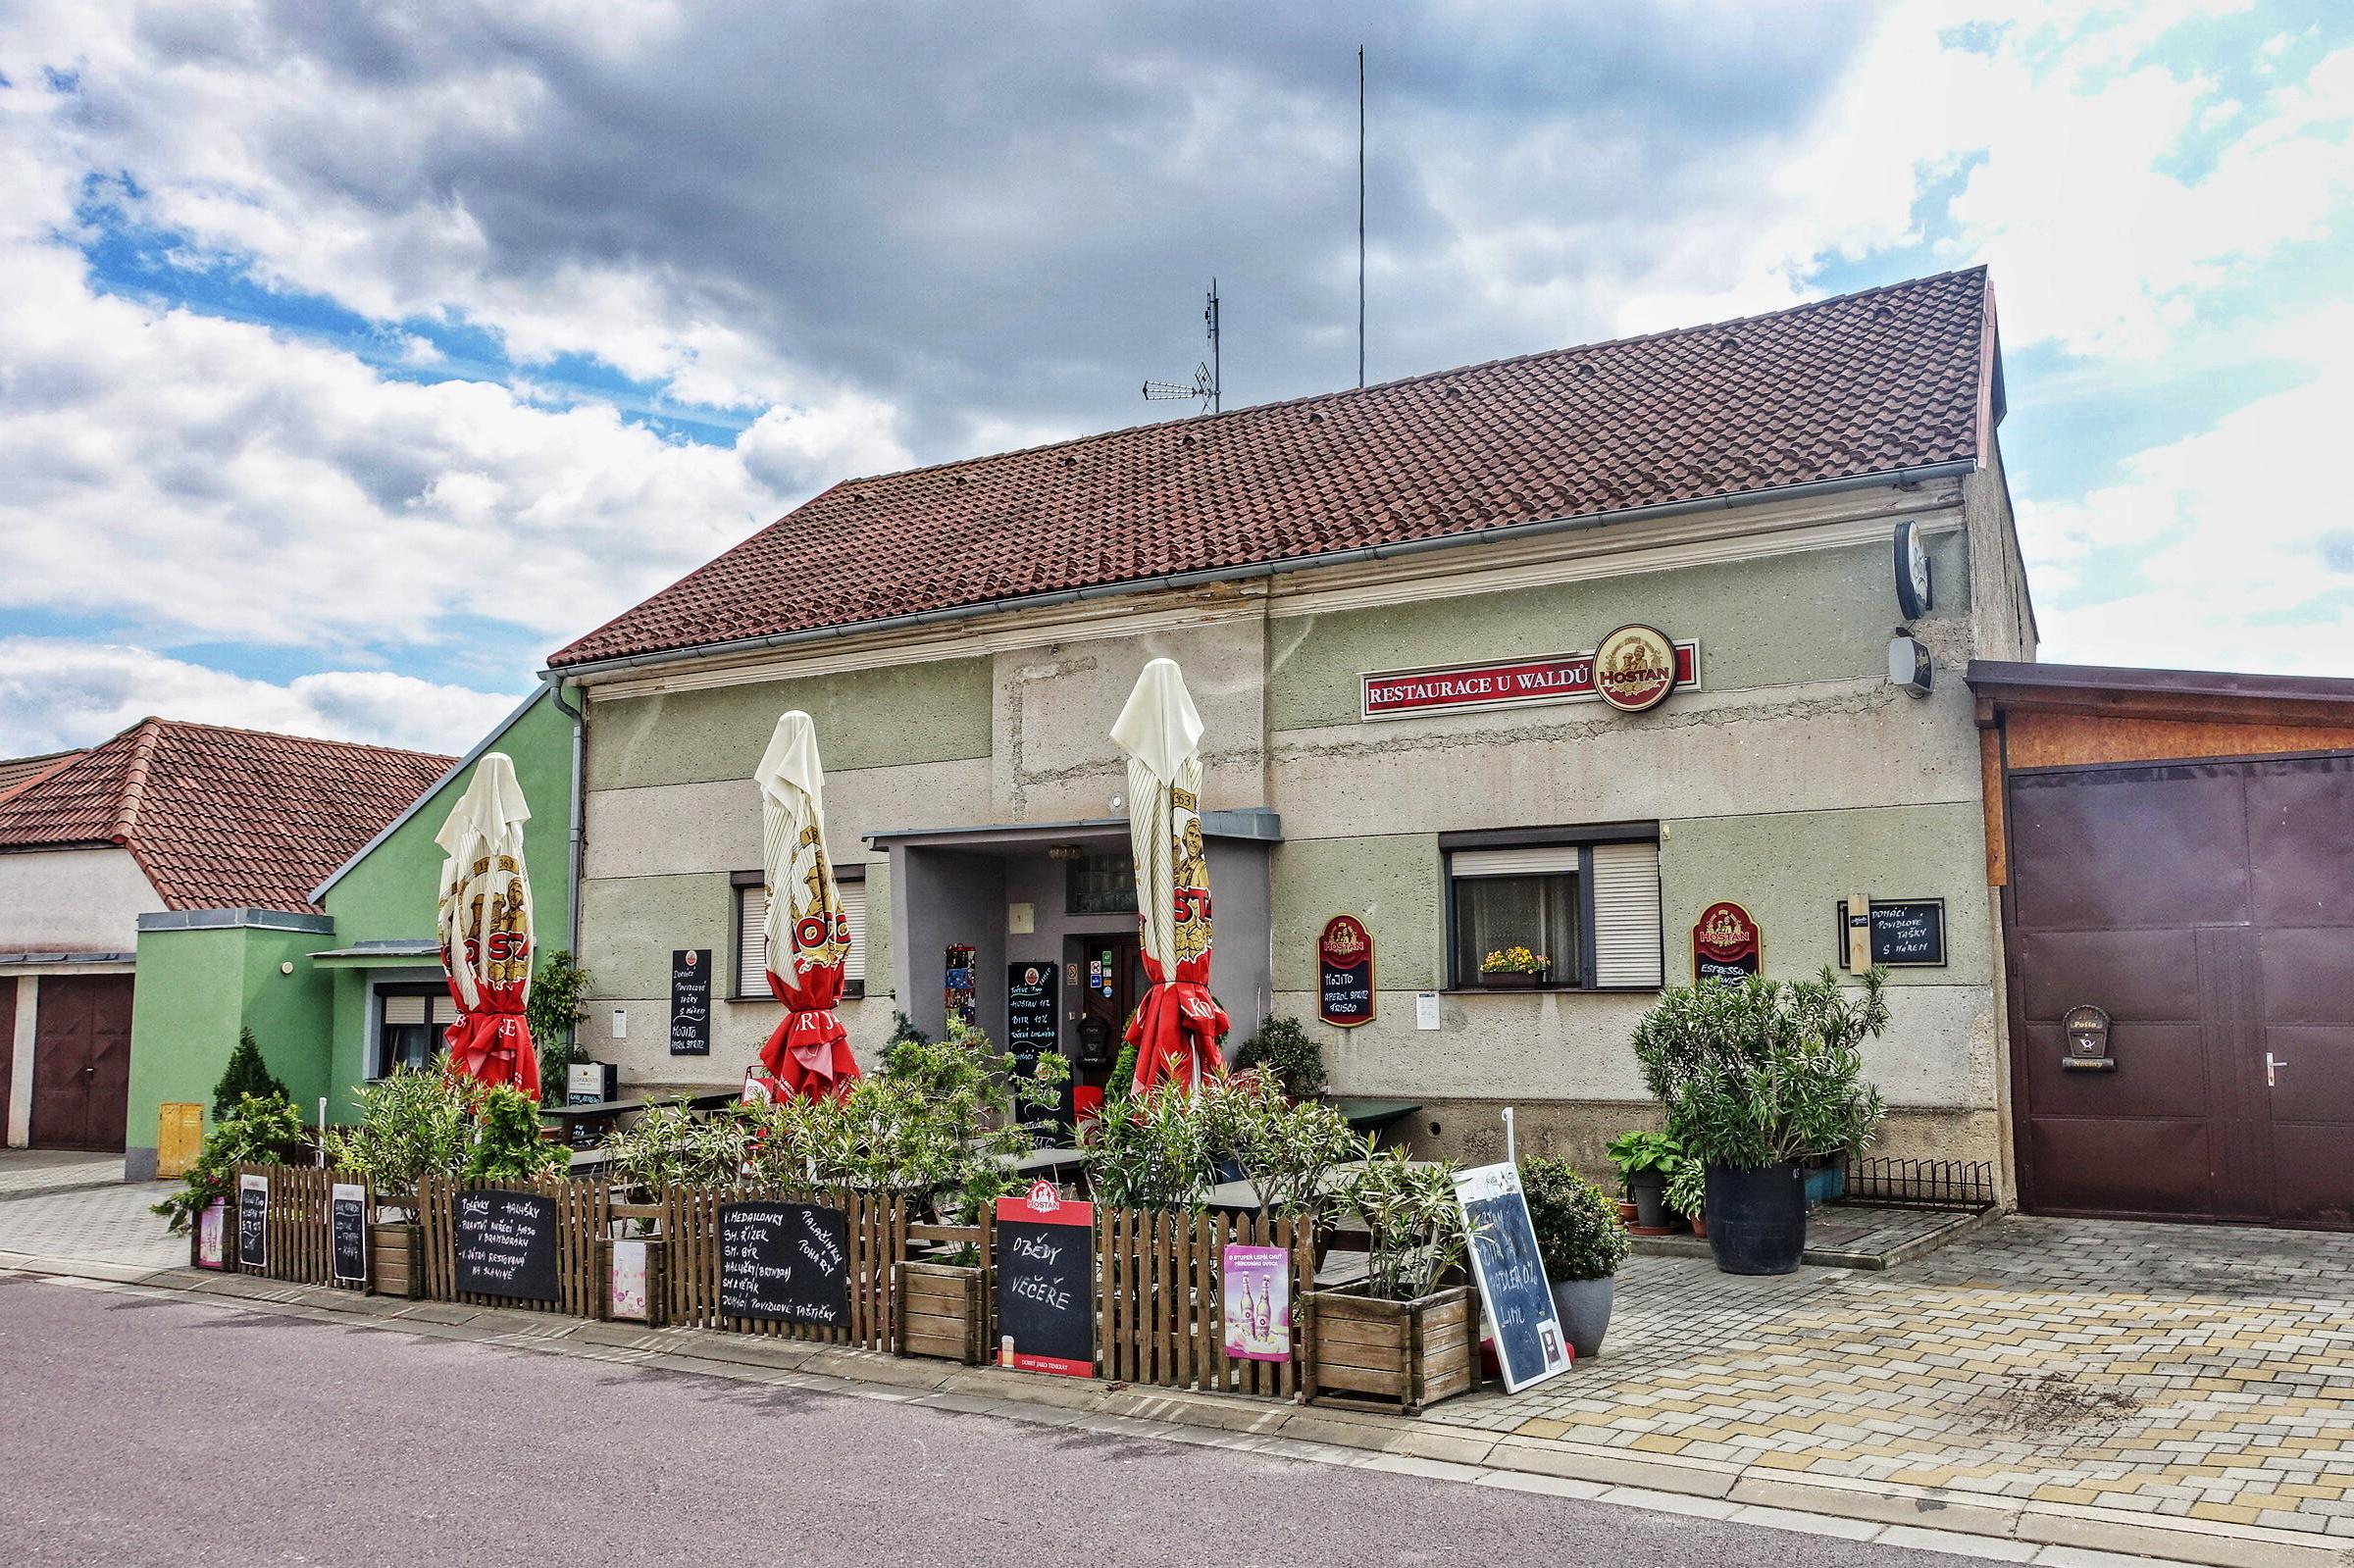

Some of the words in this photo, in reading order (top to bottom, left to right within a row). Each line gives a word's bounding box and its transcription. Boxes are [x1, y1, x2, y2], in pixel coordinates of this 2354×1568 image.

[1599, 668, 1669, 685] HOSTAN
[1369, 677, 1491, 705] RESTAURACE
[1497, 674, 1511, 691] U
[1516, 663, 1589, 689] WALDŮ
[1700, 931, 1750, 941] HOSTAN
[1323, 941, 1364, 951] HOSTAN
[1883, 943, 1890, 955] S
[1701, 964, 1744, 975] ESPRESSO
[1325, 974, 1354, 986] MOJITO
[1325, 992, 1349, 1002] APEROL
[673, 1026, 696, 1038] MOJITO
[1027, 1198, 1060, 1210] HOSTAN
[741, 1224, 769, 1242] ŘÍZEK
[802, 1210, 843, 1265] PALAČINKY
[1013, 1233, 1063, 1266] OBĚDY
[798, 1239, 835, 1278] POHÁRY
[1011, 1275, 1072, 1311] VEČEŘE
[795, 1303, 837, 1322] TAŠTIČKY
